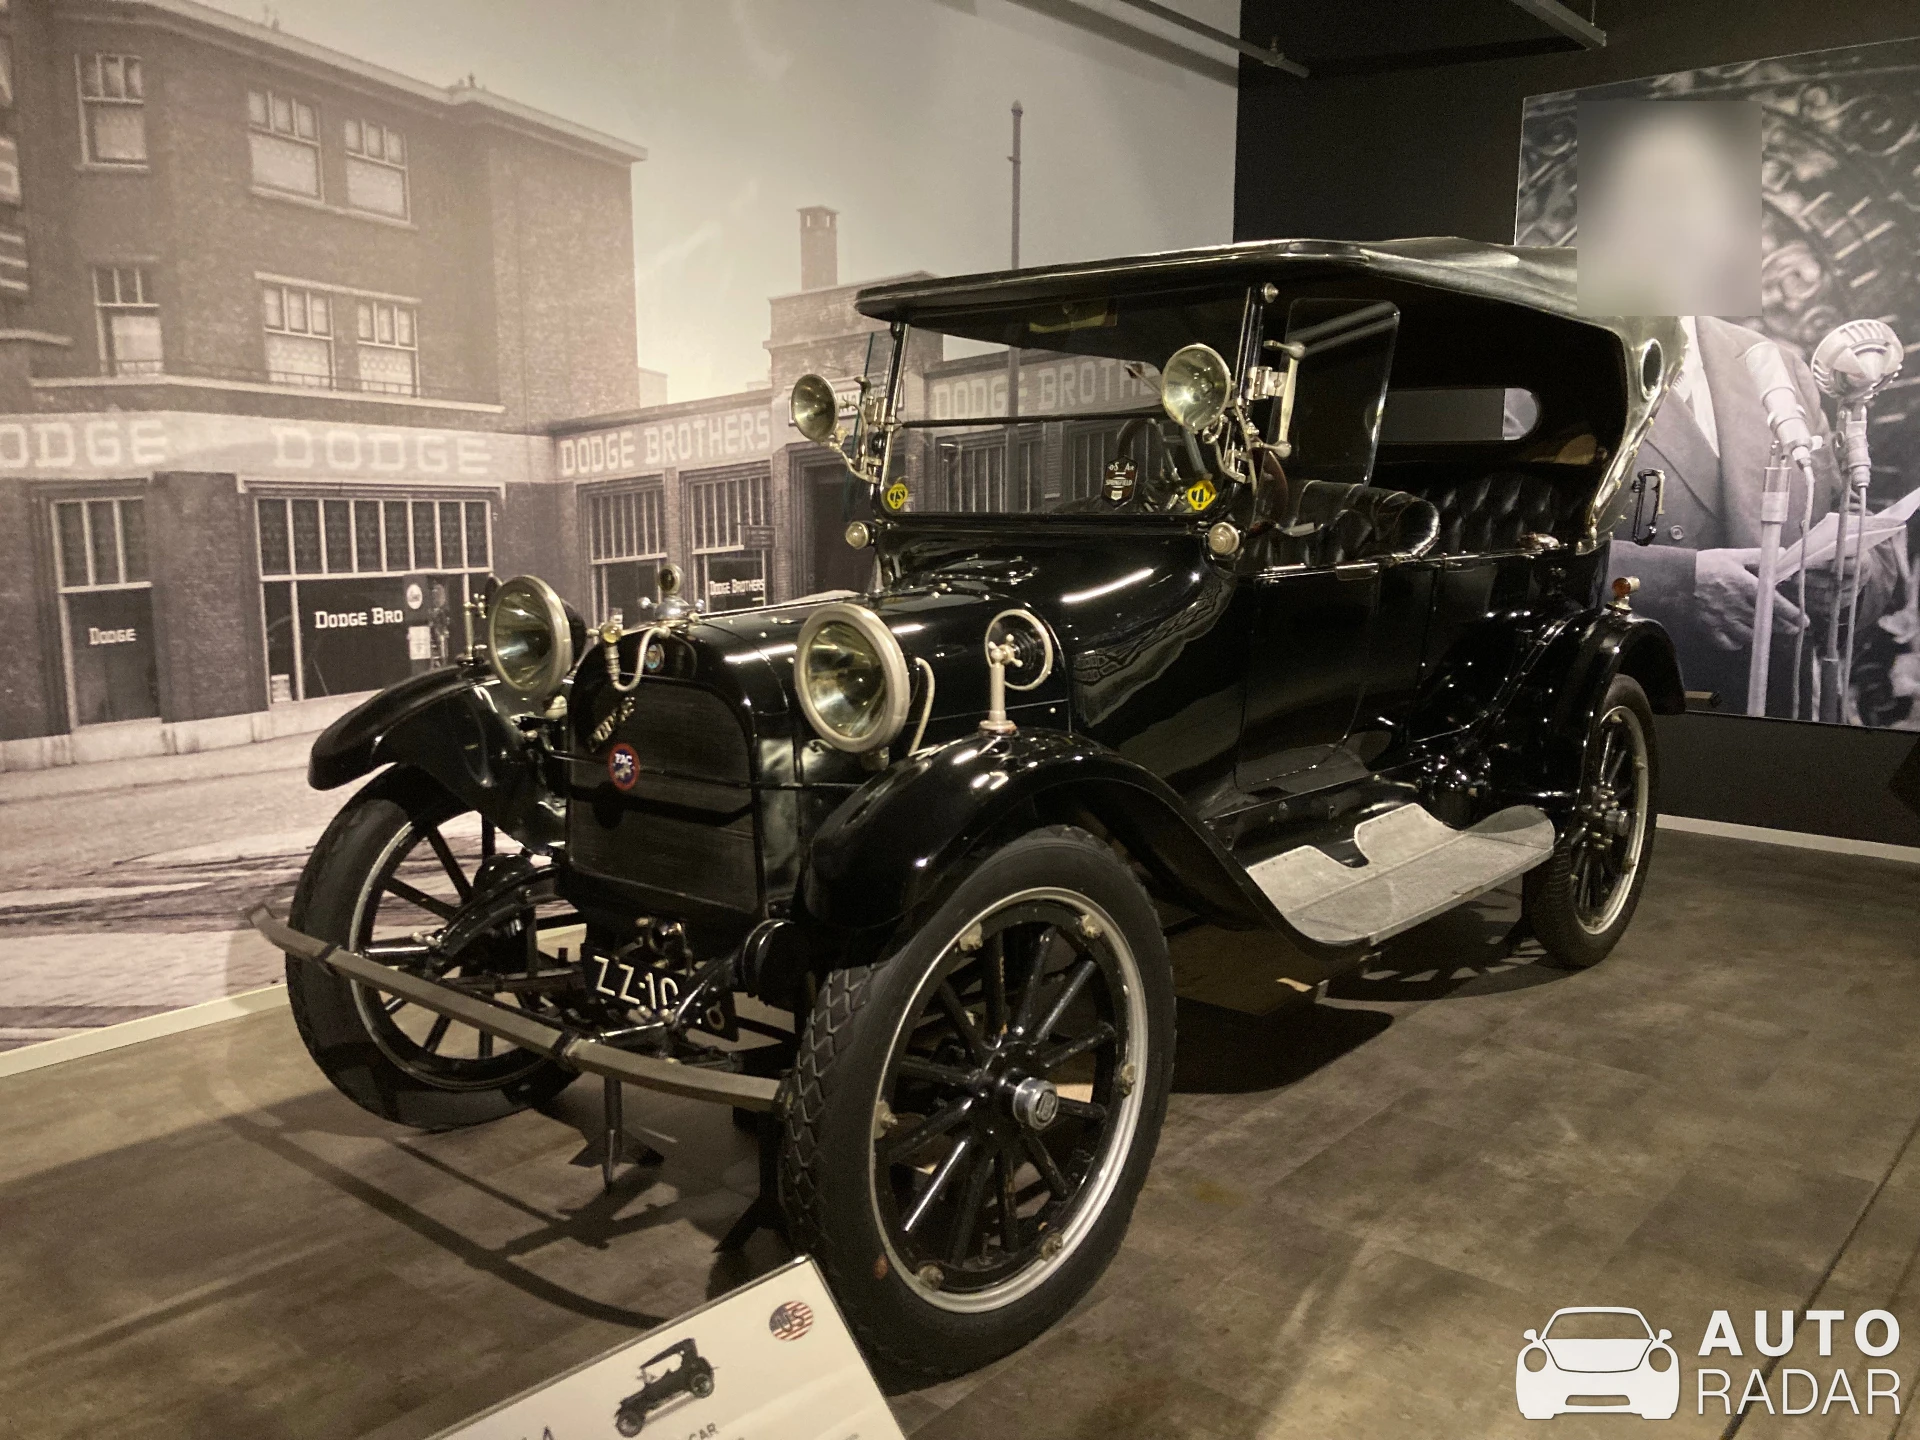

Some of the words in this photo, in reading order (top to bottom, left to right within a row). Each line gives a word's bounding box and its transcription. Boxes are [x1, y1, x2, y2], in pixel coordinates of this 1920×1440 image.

[270, 426, 492, 474] DODGE
[560, 430, 636, 476] DODGE
[644, 410, 771, 465] BROTHERS
[314, 611, 368, 629] DODGE
[371, 607, 404, 625] BRO
[88, 627, 137, 645] DODGE
